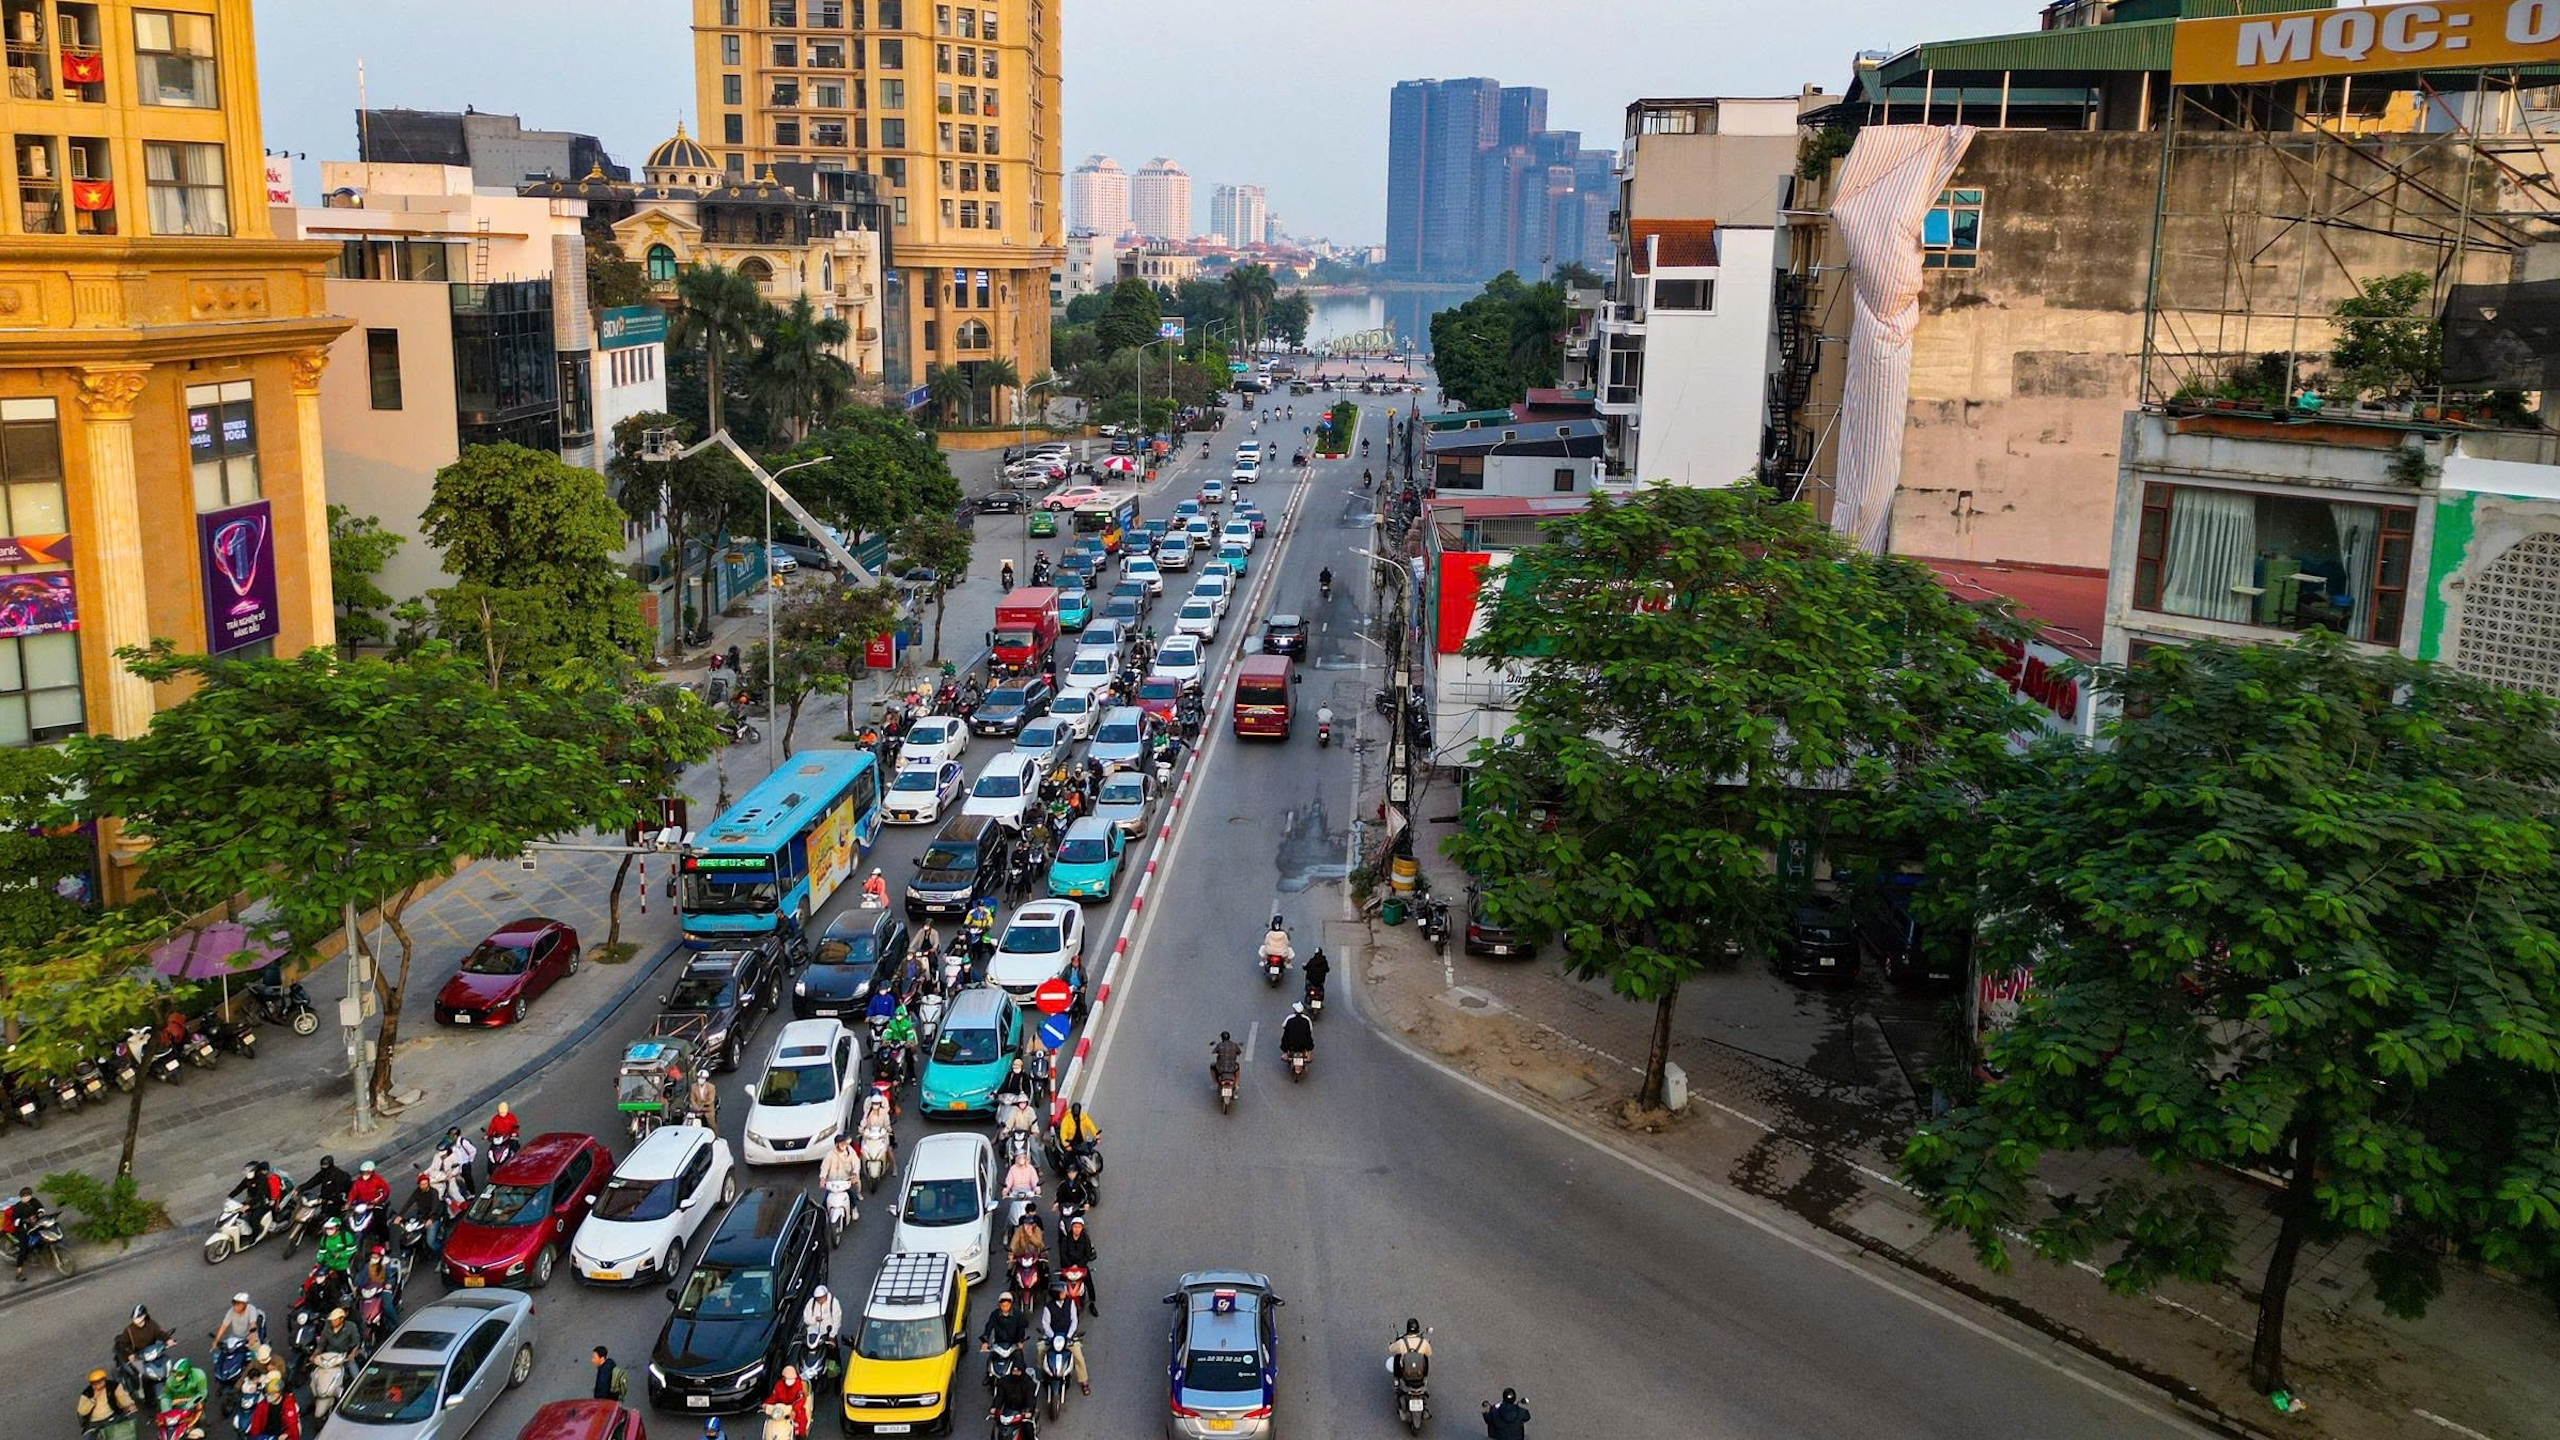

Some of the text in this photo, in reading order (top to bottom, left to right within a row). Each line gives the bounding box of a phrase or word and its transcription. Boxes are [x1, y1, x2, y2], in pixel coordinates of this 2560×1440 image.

[2236, 4, 2470, 67] MQC:
[223, 429, 247, 442] YOGA
[124, 1161, 131, 1173] 2
[1218, 1299, 1230, 1311] G7
